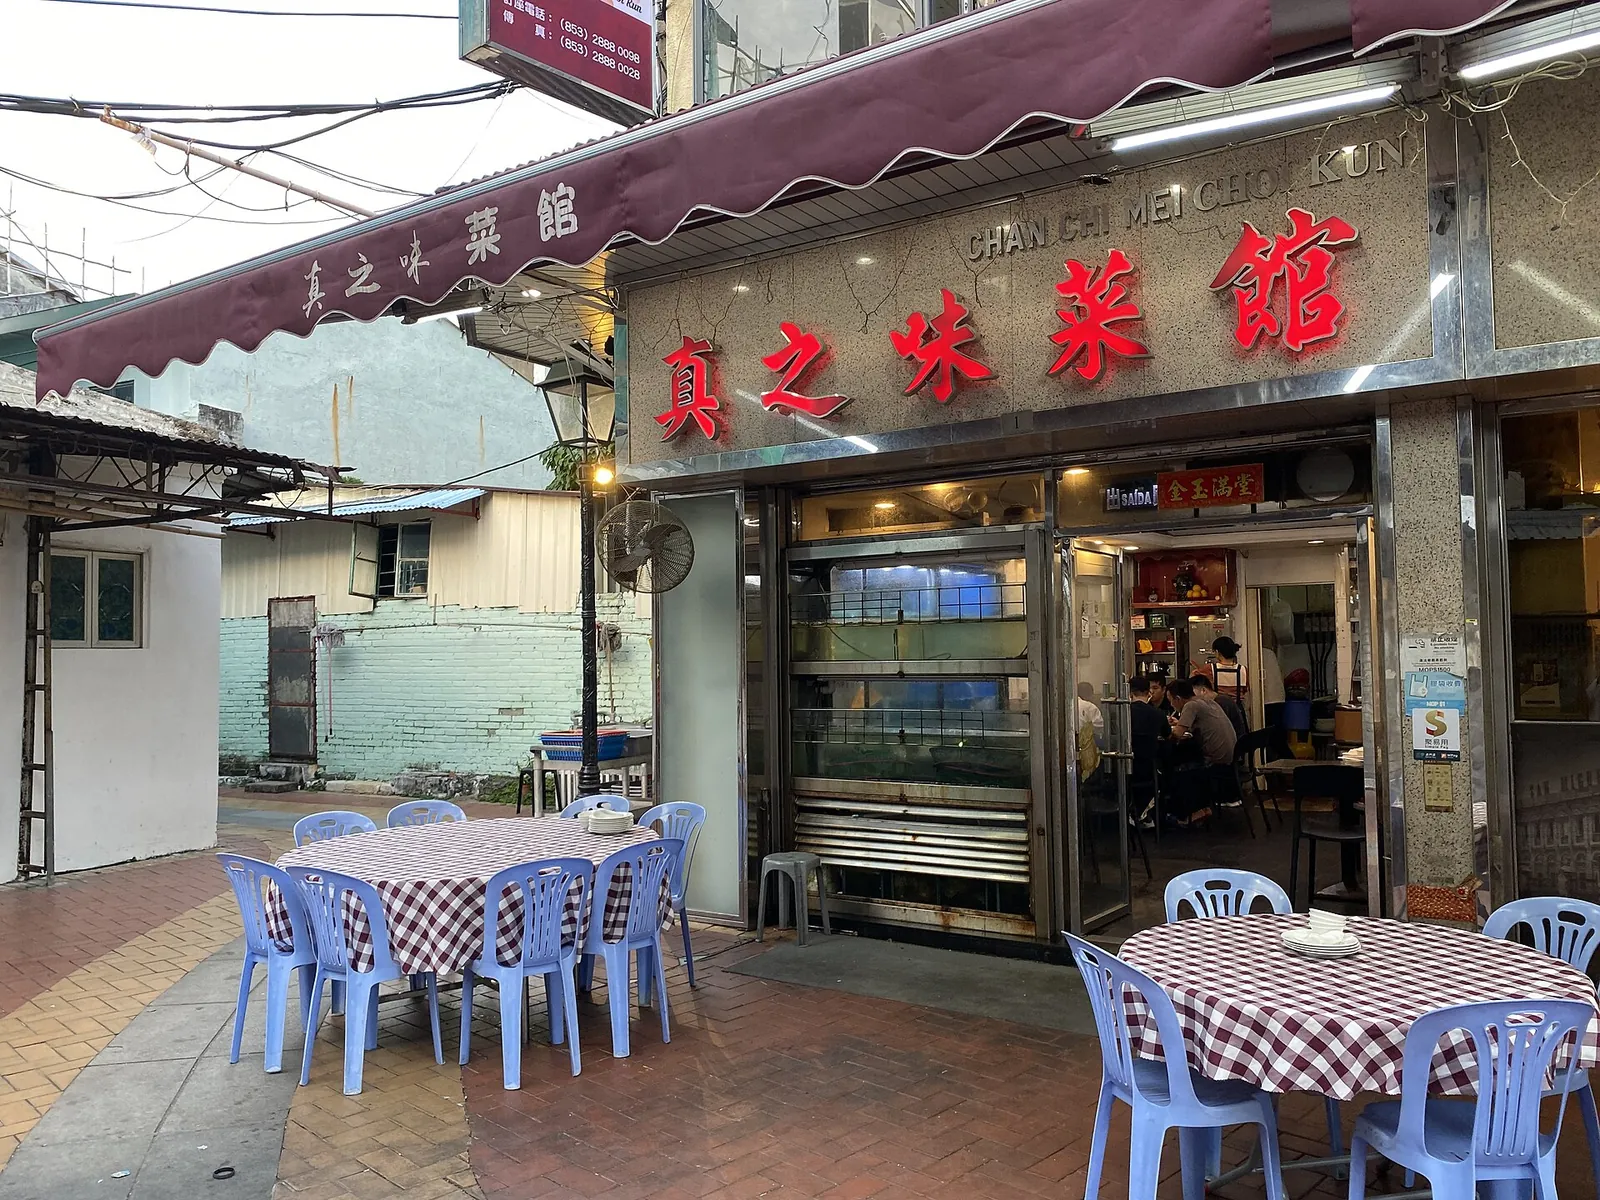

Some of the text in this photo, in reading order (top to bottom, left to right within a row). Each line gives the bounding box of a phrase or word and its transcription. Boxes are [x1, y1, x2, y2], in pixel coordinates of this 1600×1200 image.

[560, 18, 588, 40] (853)
[592, 34, 616, 53] 2888
[617, 46, 640, 64] 0098
[560, 35, 588, 57] (853)
[592, 51, 616, 69] 2888
[617, 62, 640, 80] 0028
[302, 182, 579, 319] 真之味菜館
[968, 216, 1046, 262] CHAN
[1059, 203, 1110, 241] CHI
[1126, 184, 1182, 230] MEI
[1309, 134, 1408, 187] KUN
[654, 206, 1361, 442] 真之味菜館
